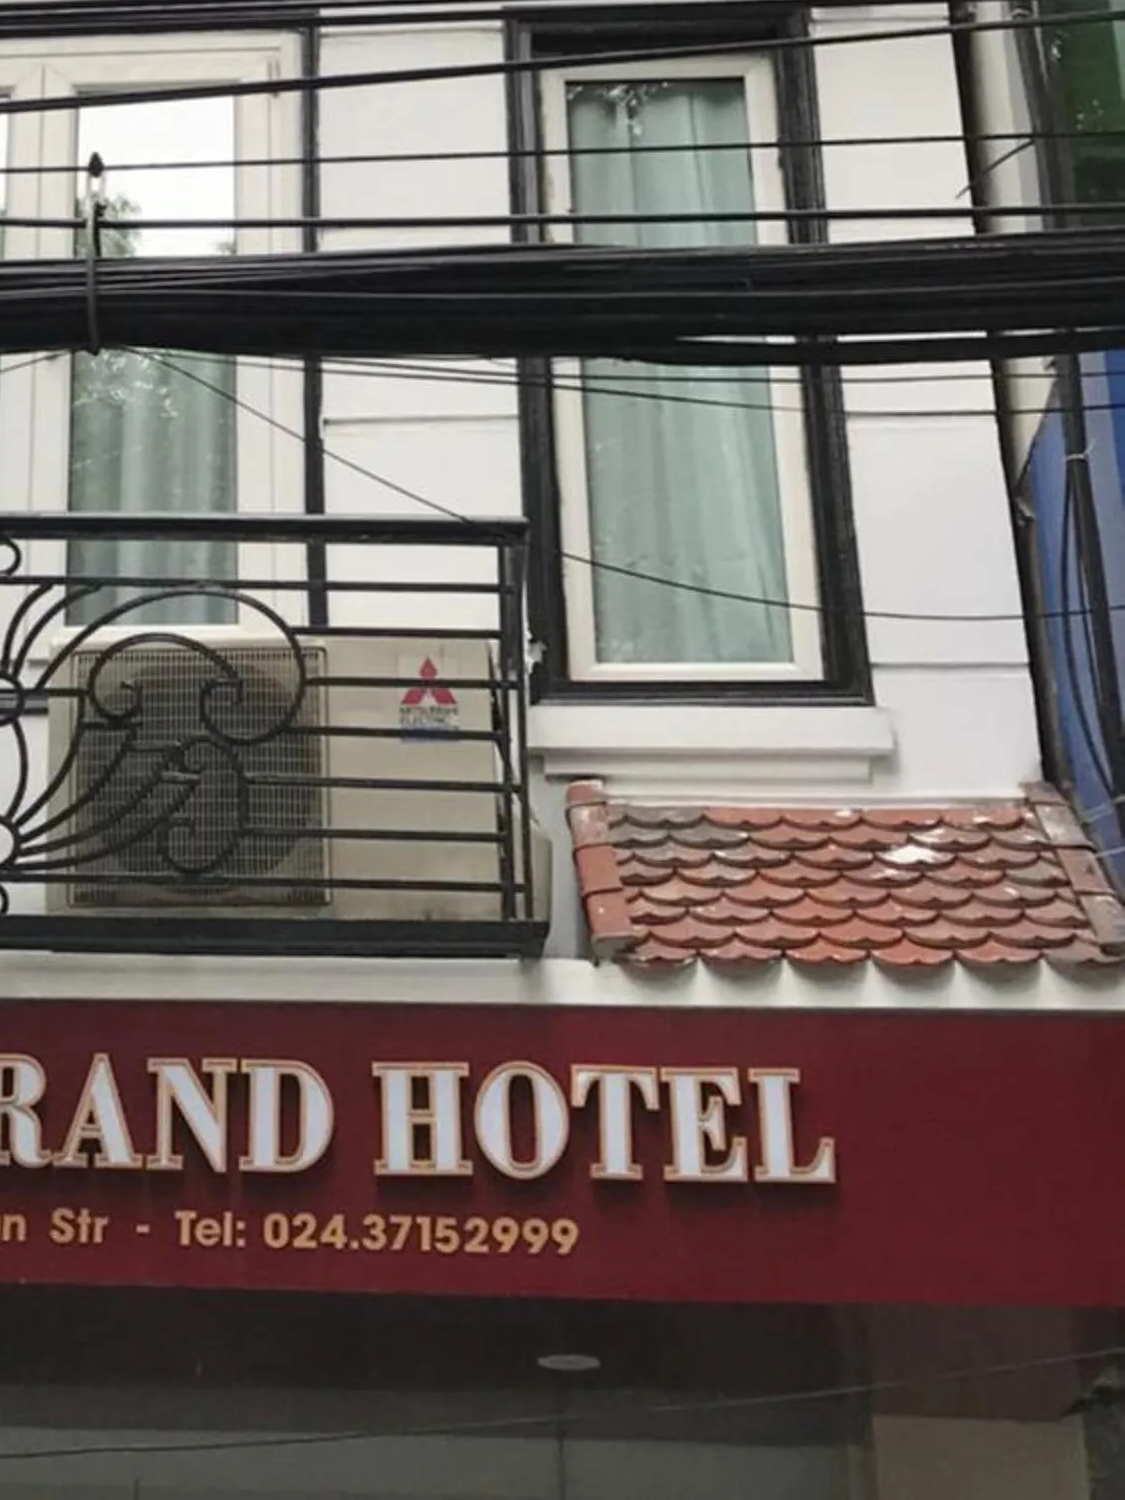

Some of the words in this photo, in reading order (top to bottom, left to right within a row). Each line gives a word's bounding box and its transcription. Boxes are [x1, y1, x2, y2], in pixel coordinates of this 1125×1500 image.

[370, 1059, 837, 1185] HOTEL
[48, 1206, 110, 1244] Str
[174, 1209, 247, 1248] Tel:
[262, 1211, 580, 1256] 024.37152999
